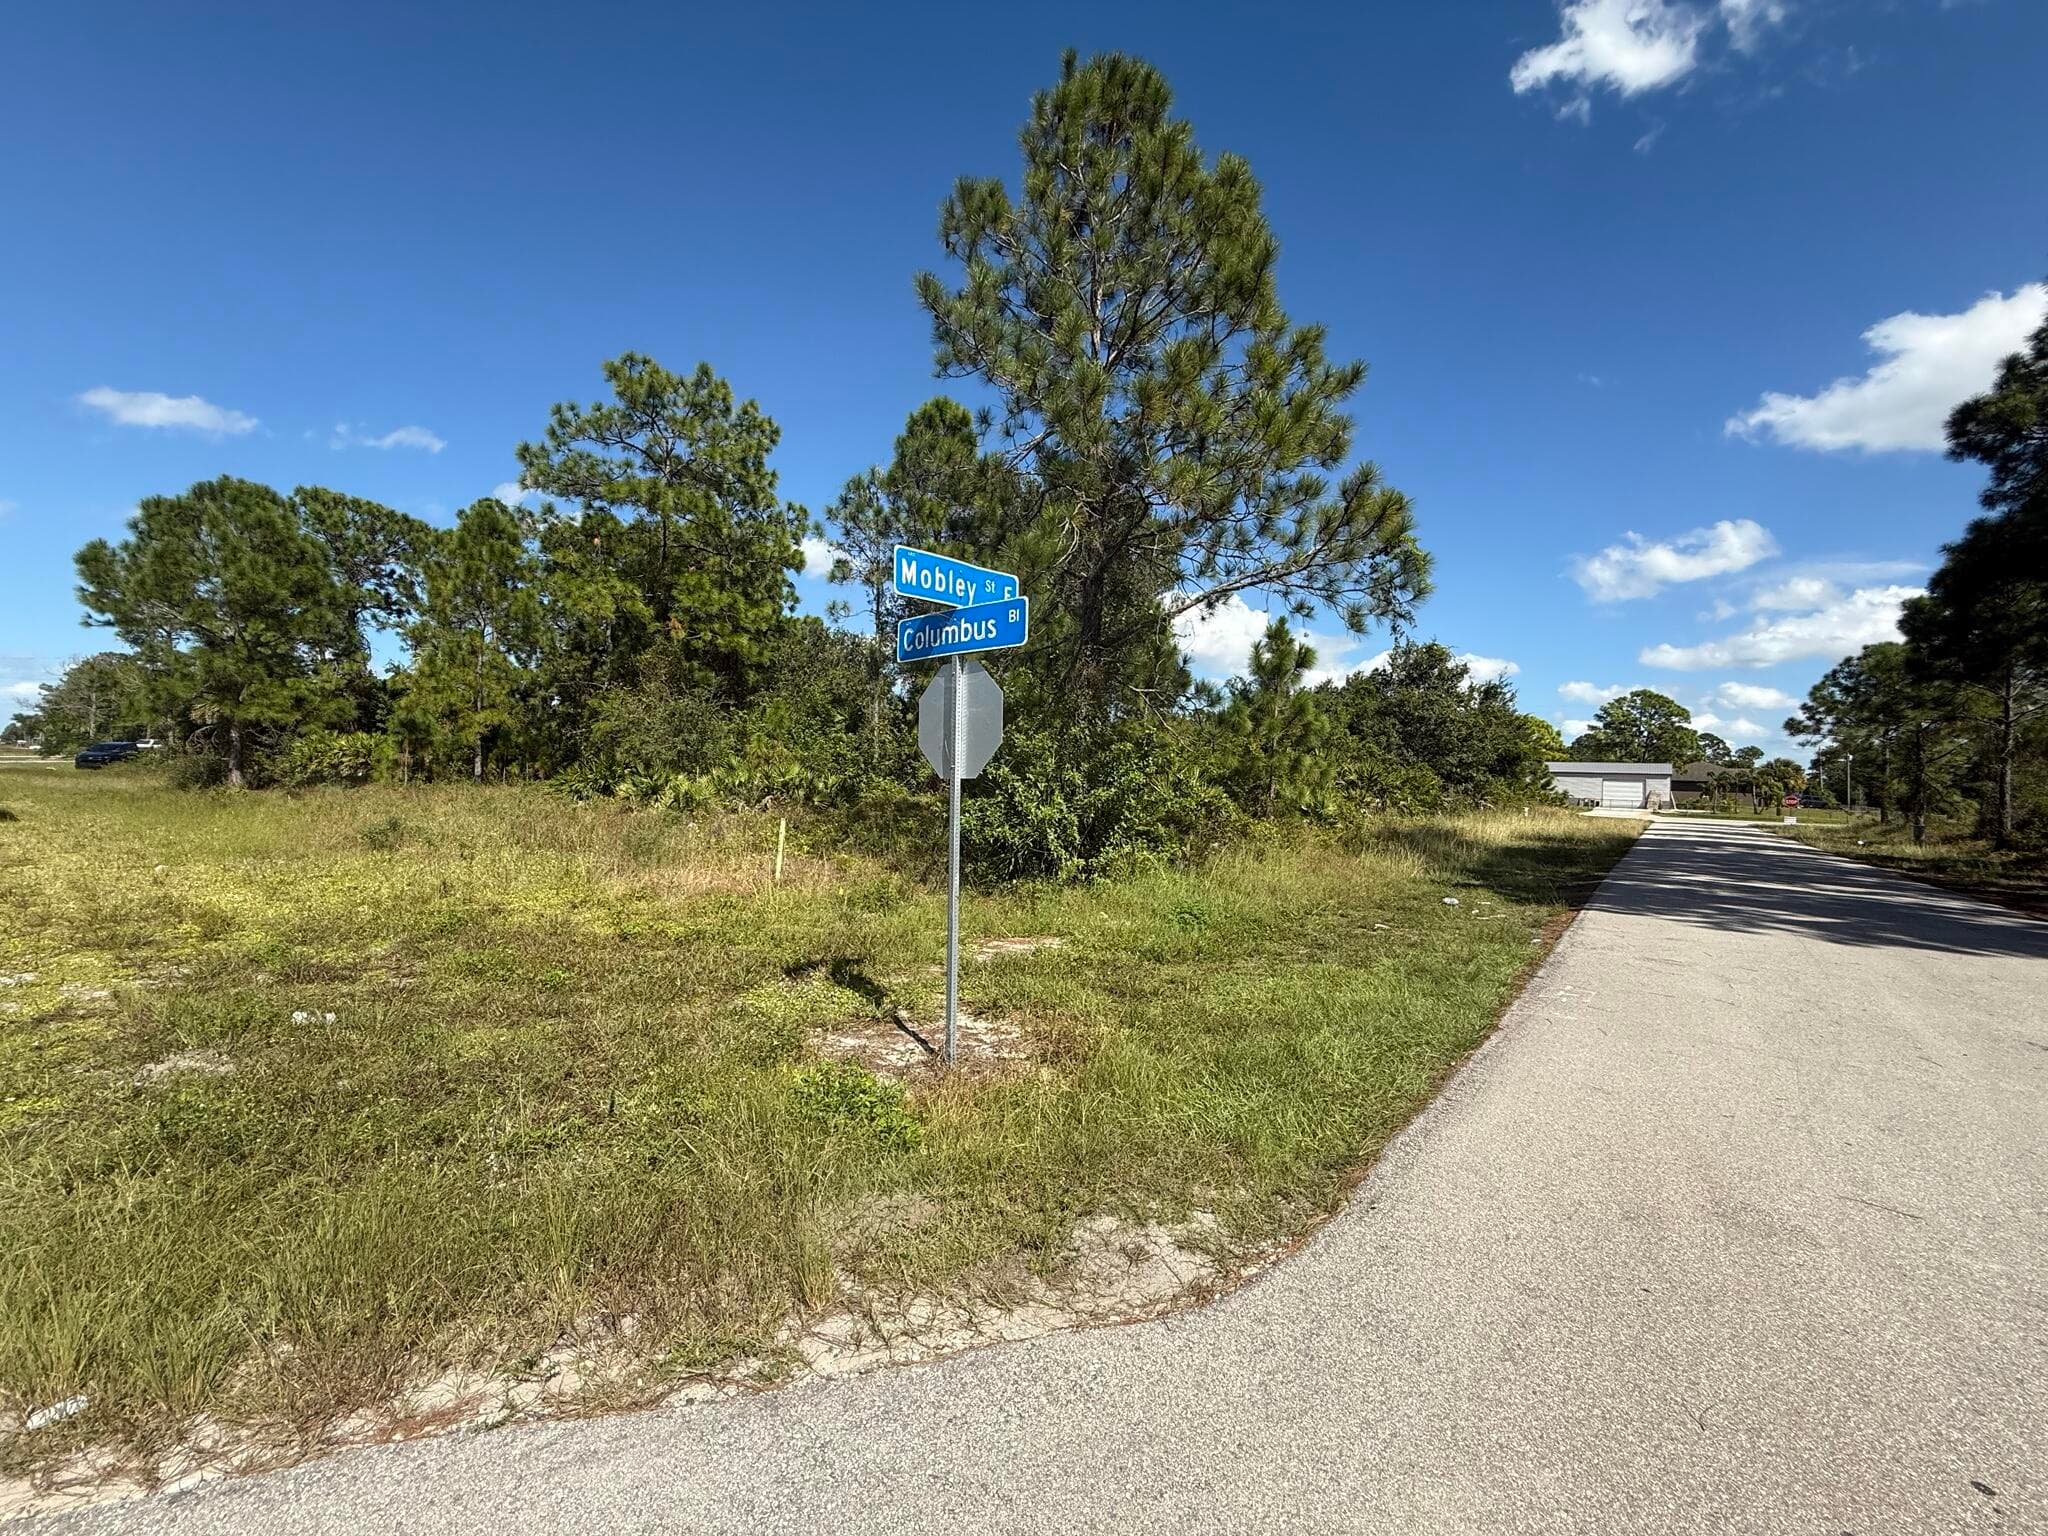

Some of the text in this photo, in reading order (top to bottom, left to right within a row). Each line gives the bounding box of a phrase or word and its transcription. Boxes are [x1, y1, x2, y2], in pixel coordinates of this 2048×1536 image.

[901, 558, 976, 606] Mobley
[985, 579, 996, 594] St
[903, 617, 997, 652] Columbus
